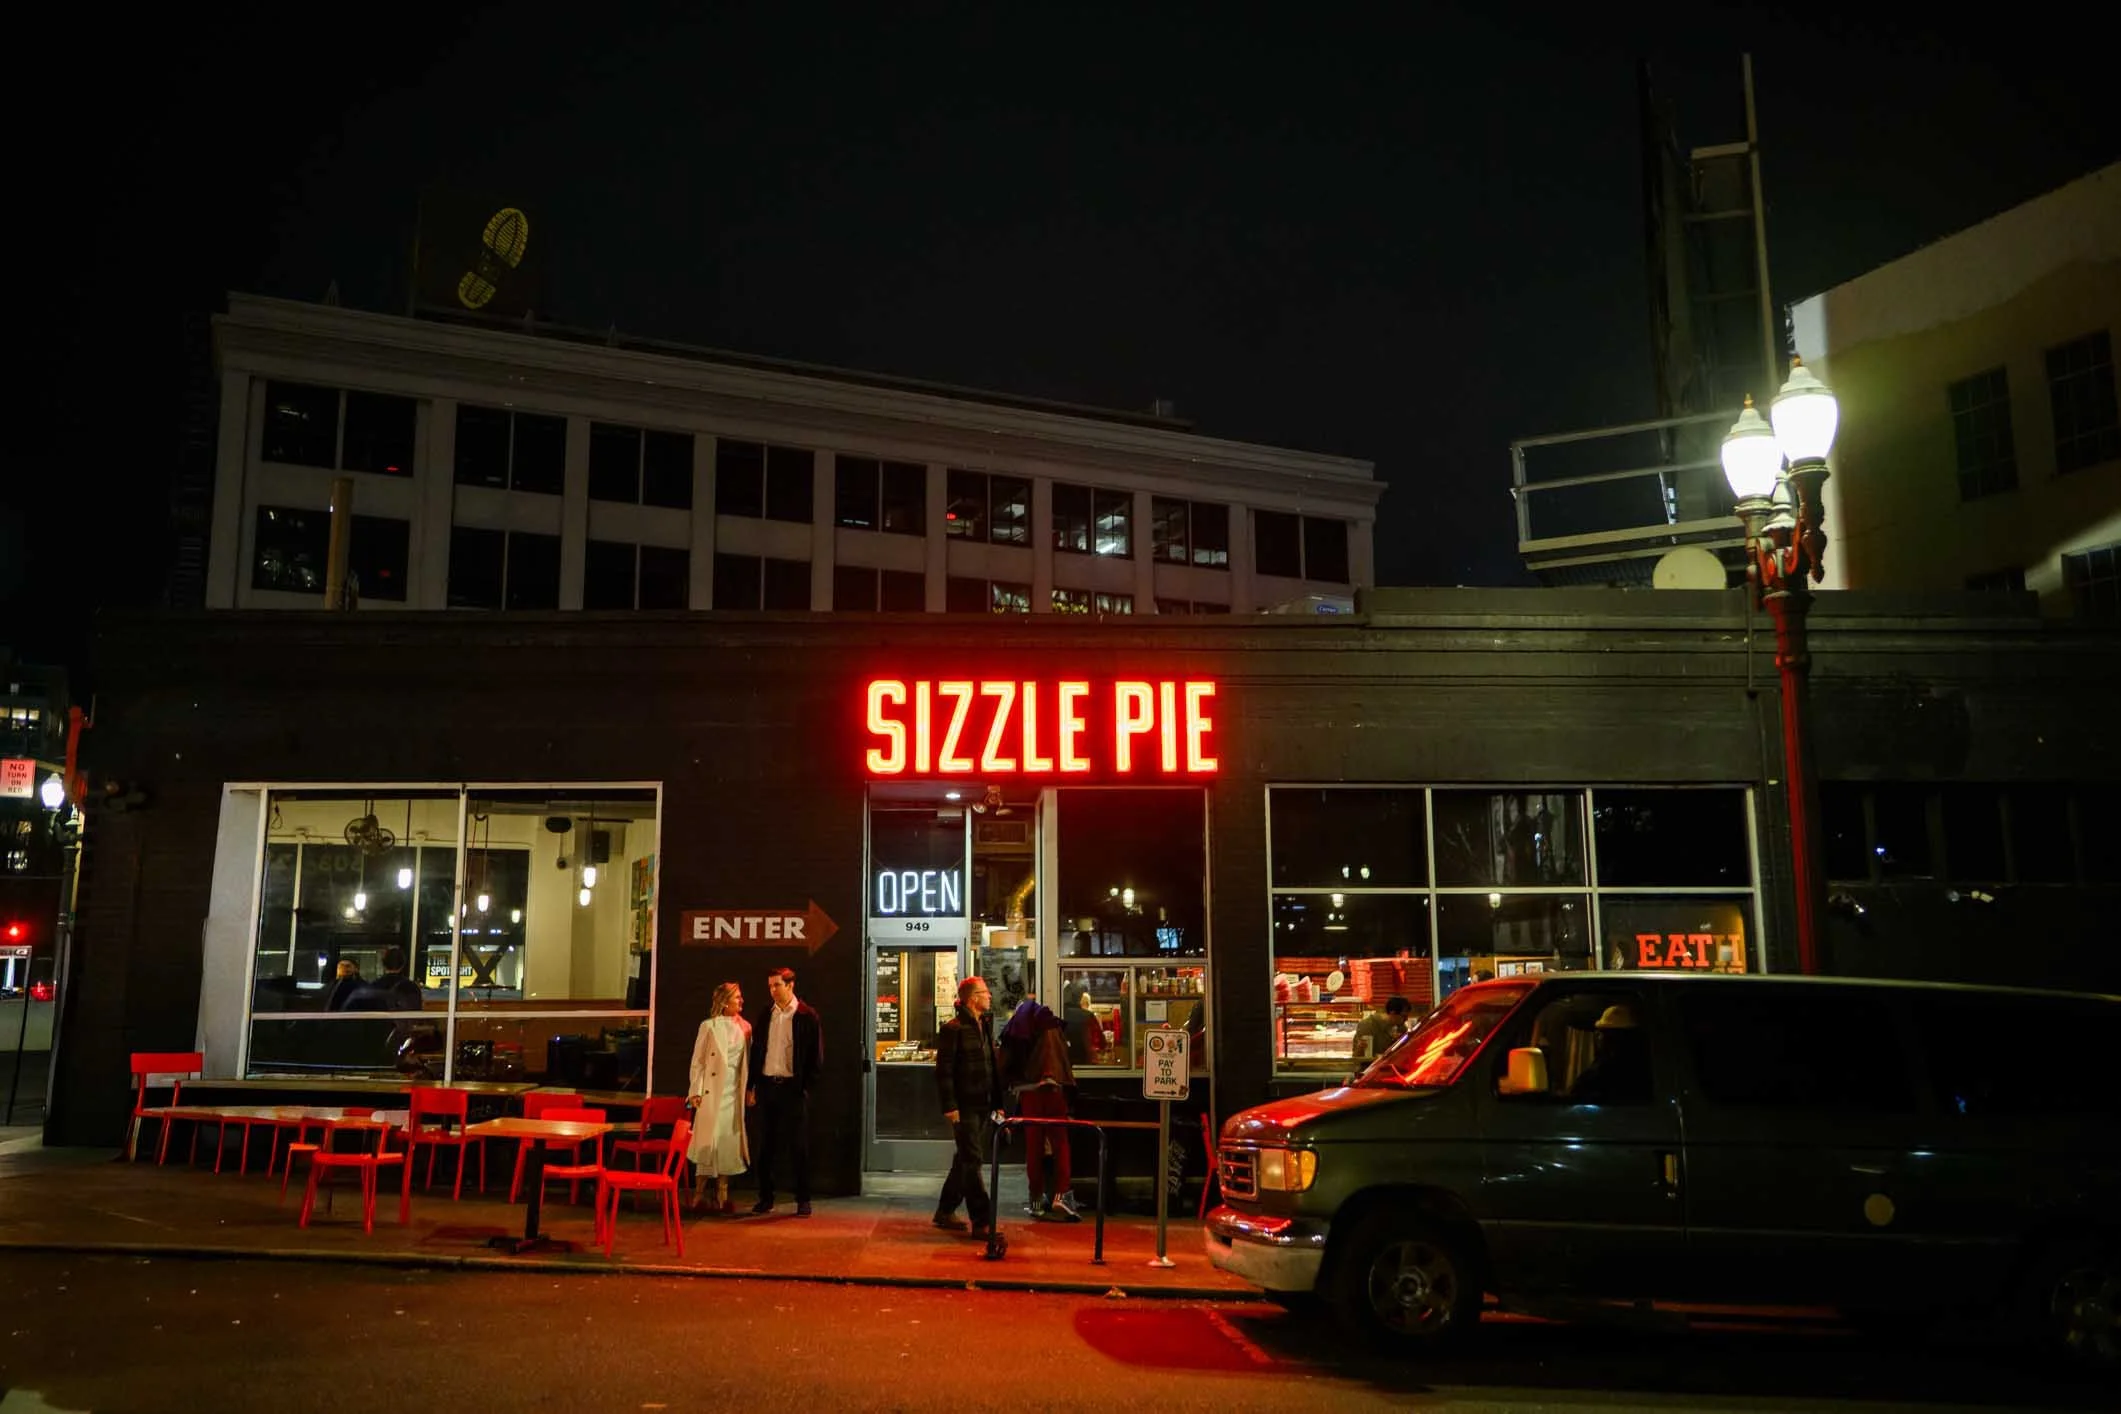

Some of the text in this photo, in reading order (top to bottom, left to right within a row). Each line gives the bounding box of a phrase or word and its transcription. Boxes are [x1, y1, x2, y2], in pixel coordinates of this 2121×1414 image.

[866, 679, 1218, 774] SIZZLE PIE
[10, 763, 25, 771] NO
[879, 871, 960, 913] OPEN
[693, 917, 806, 939] ENTER
[905, 922, 930, 931] 949
[1158, 1060, 1174, 1068] PAY
[1161, 1068, 1172, 1076] TO
[1154, 1077, 1177, 1085] PARK
